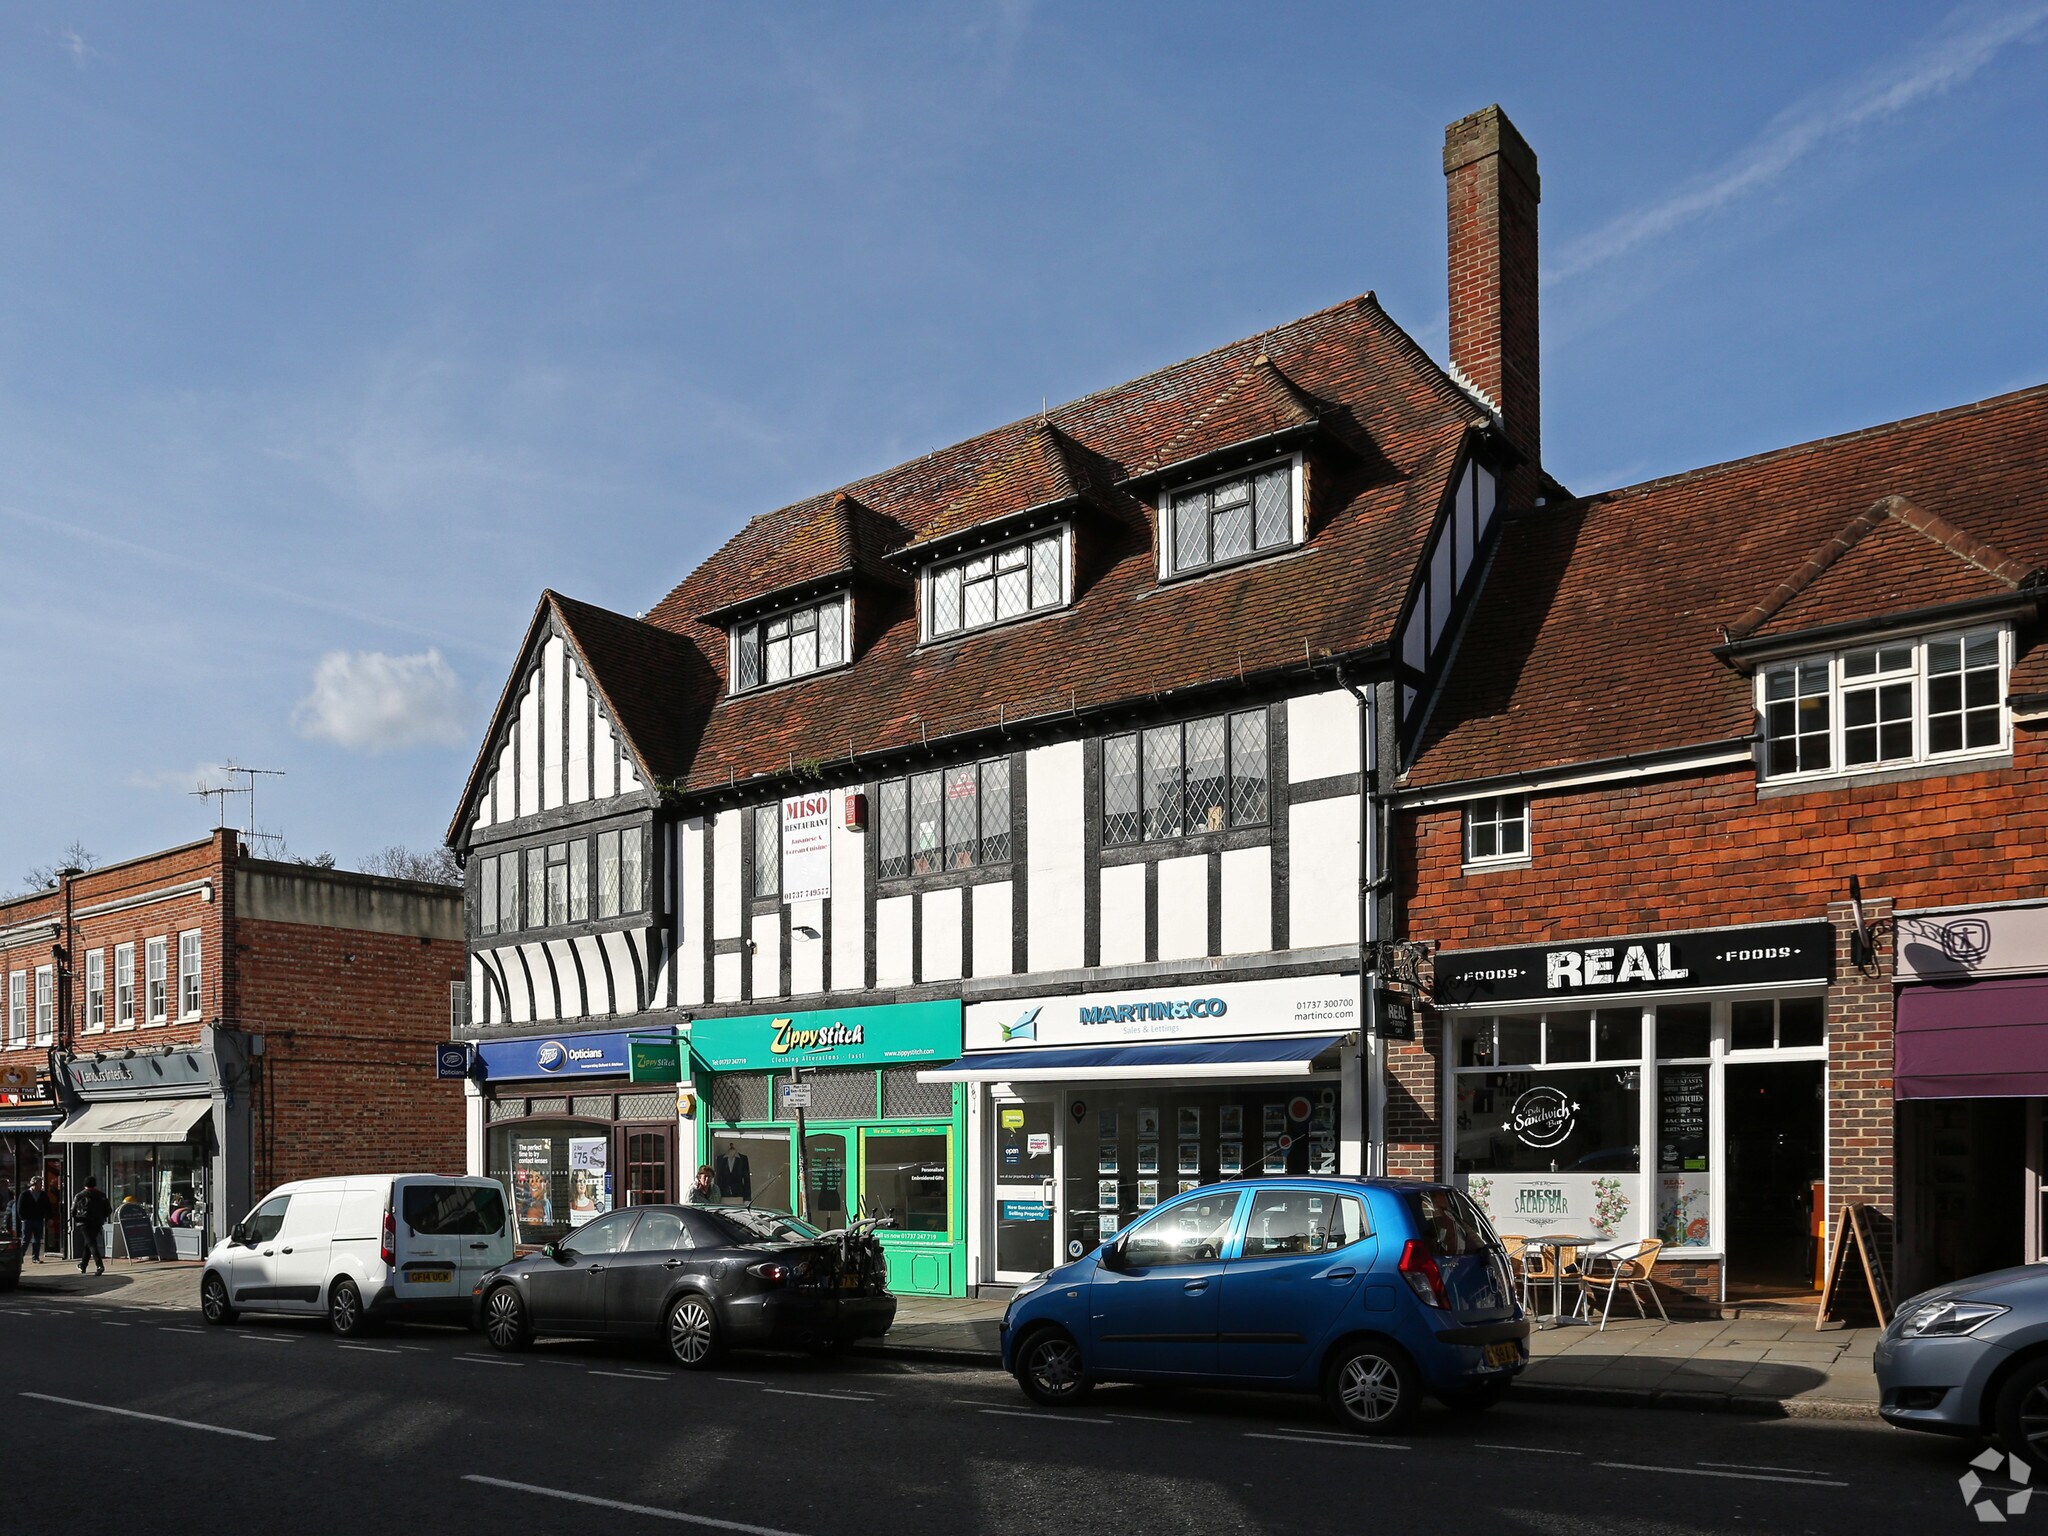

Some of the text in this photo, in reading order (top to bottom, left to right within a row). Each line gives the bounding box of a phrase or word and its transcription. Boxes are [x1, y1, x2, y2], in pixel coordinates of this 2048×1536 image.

[786, 797, 827, 820] MISO
[784, 818, 828, 832] RESTAURANT
[784, 887, 829, 900] 01737 749577
[1725, 946, 1790, 962] FOODS
[1546, 942, 1688, 989] REAL
[1464, 968, 1518, 981] FOODS
[1079, 997, 1226, 1025] MARTIN&CO
[1296, 999, 1354, 1010] 01737 300700
[1294, 1010, 1354, 1021] martinco.com
[1388, 1003, 1407, 1021] REAL
[1123, 1025, 1179, 1034] Sales & Lettings
[539, 1048, 558, 1064] Boots
[569, 1049, 602, 1061] Opticians
[801, 1054, 839, 1063] Alterations
[884, 1048, 934, 1057] www.zippystitch.com
[1513, 1100, 1571, 1131] Sandwich
[1526, 1106, 1541, 1117] Deli
[1546, 1119, 1563, 1128] Bar
[573, 1152, 588, 1164] £75
[1005, 1148, 1019, 1156] open
[1519, 1189, 1562, 1202] FRESH
[1514, 1197, 1569, 1214] SALAD BAR
